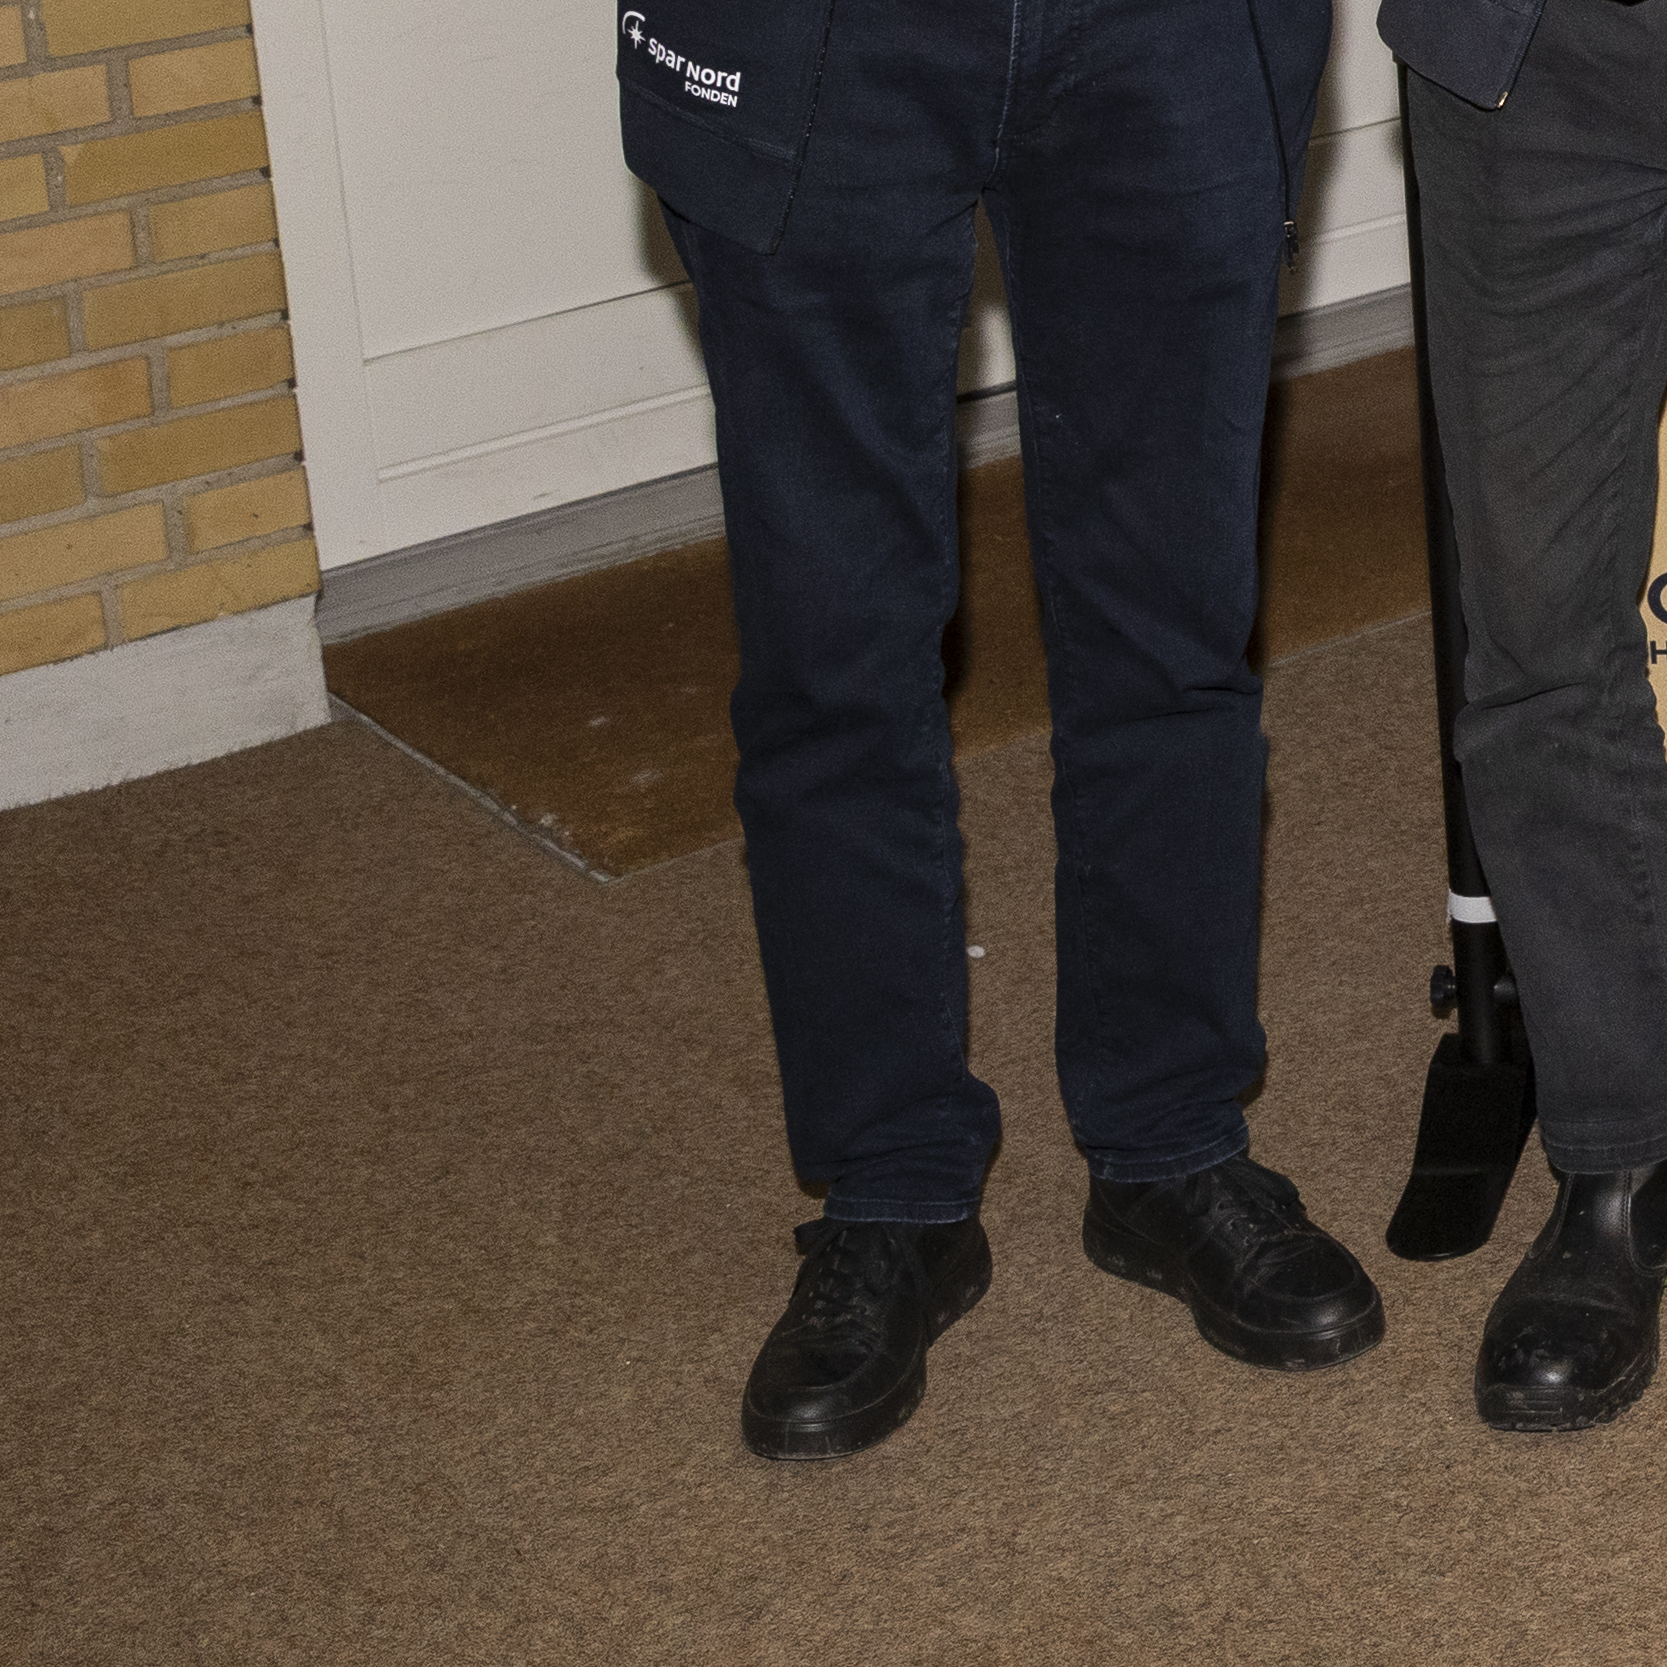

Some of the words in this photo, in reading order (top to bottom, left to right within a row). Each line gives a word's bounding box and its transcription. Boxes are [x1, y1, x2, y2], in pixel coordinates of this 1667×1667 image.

[648, 37, 686, 72] spar
[686, 61, 741, 92] Nord
[685, 81, 738, 108] FONDEN
